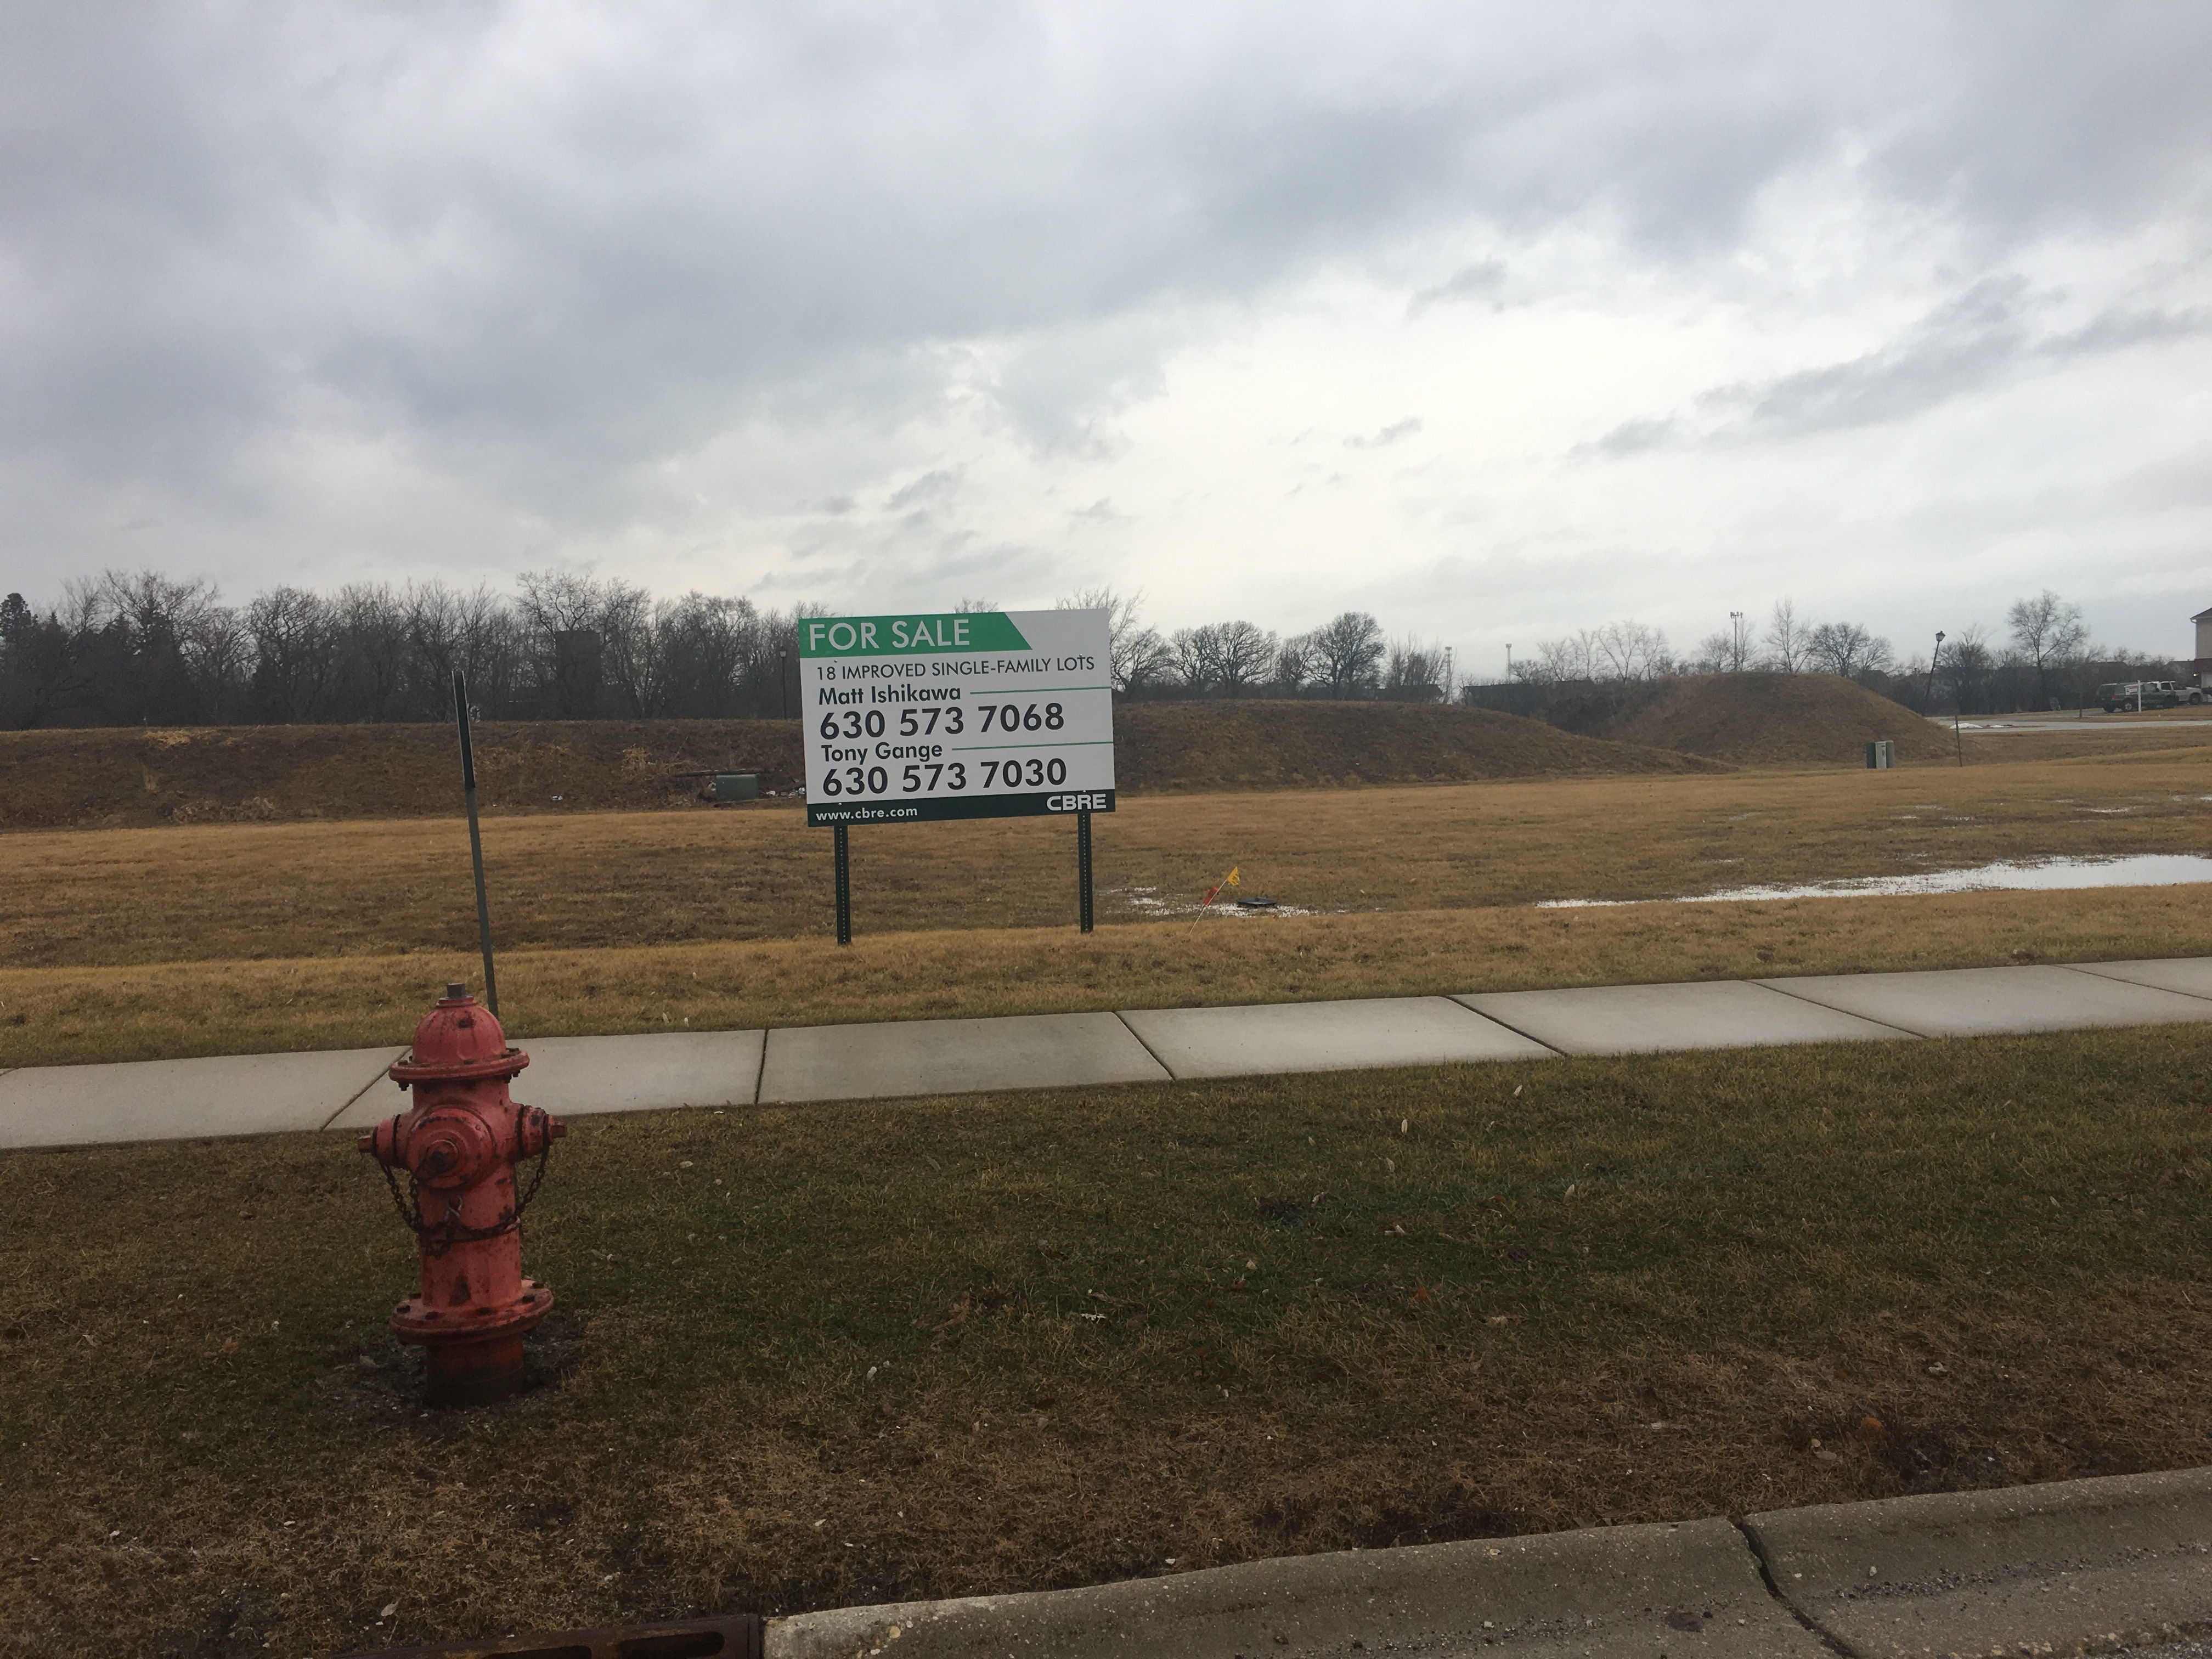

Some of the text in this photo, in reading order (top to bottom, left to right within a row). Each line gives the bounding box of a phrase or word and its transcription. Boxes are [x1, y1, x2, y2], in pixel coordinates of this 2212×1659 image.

[810, 619, 969, 651] FOR SALE
[817, 656, 1094, 680] 18 IMPROVED SINGLE-FAMILY LOTS
[819, 684, 960, 705] Matt Ishikawa
[820, 703, 1064, 740] 630 573 7068
[821, 742, 942, 765] Tony Gange
[823, 758, 1066, 796] 630 573 7030
[1047, 794, 1106, 810] CBRE
[816, 808, 917, 820] www.cbre.com
